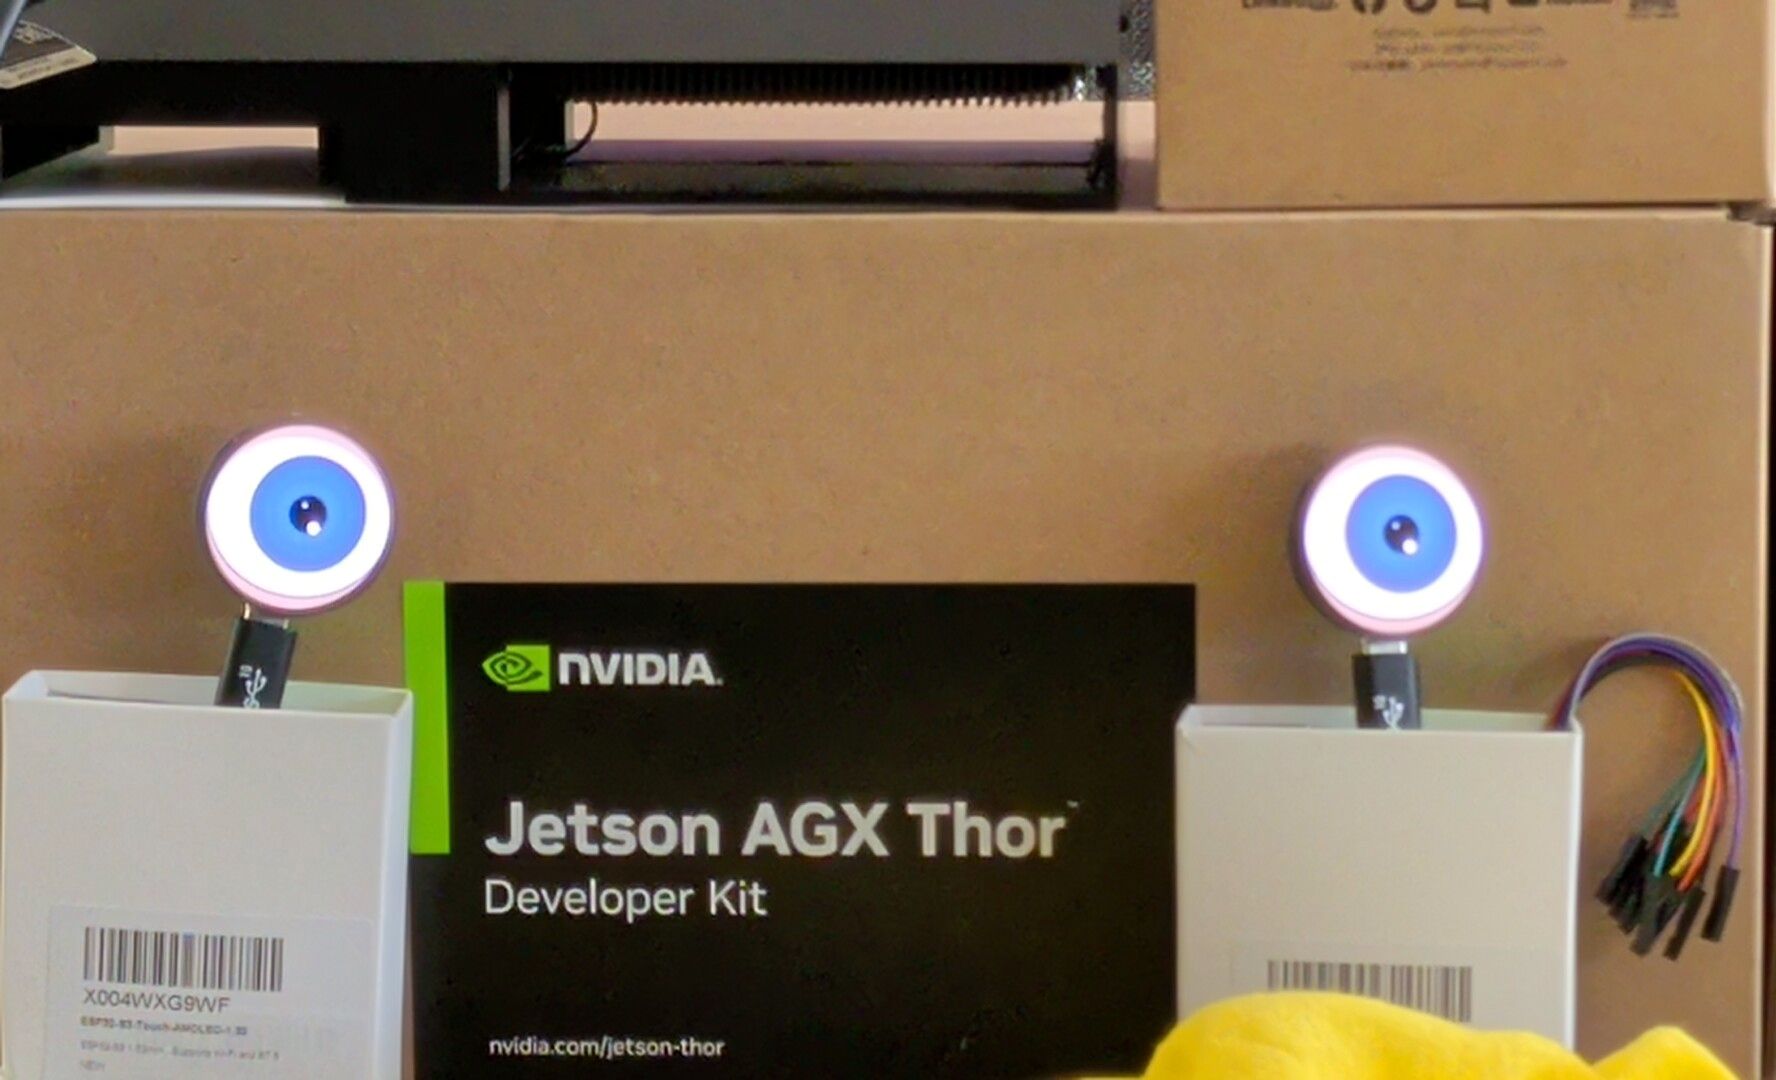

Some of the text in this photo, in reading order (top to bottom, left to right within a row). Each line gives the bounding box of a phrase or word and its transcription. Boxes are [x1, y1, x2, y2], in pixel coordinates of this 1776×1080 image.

[484, 800, 1067, 858] Jetson AGX Thor
[484, 877, 768, 924] Developer Kit
[83, 987, 231, 1013] X004WXG9WF
[488, 1035, 726, 1060] nvidia.com/jetson-thor
